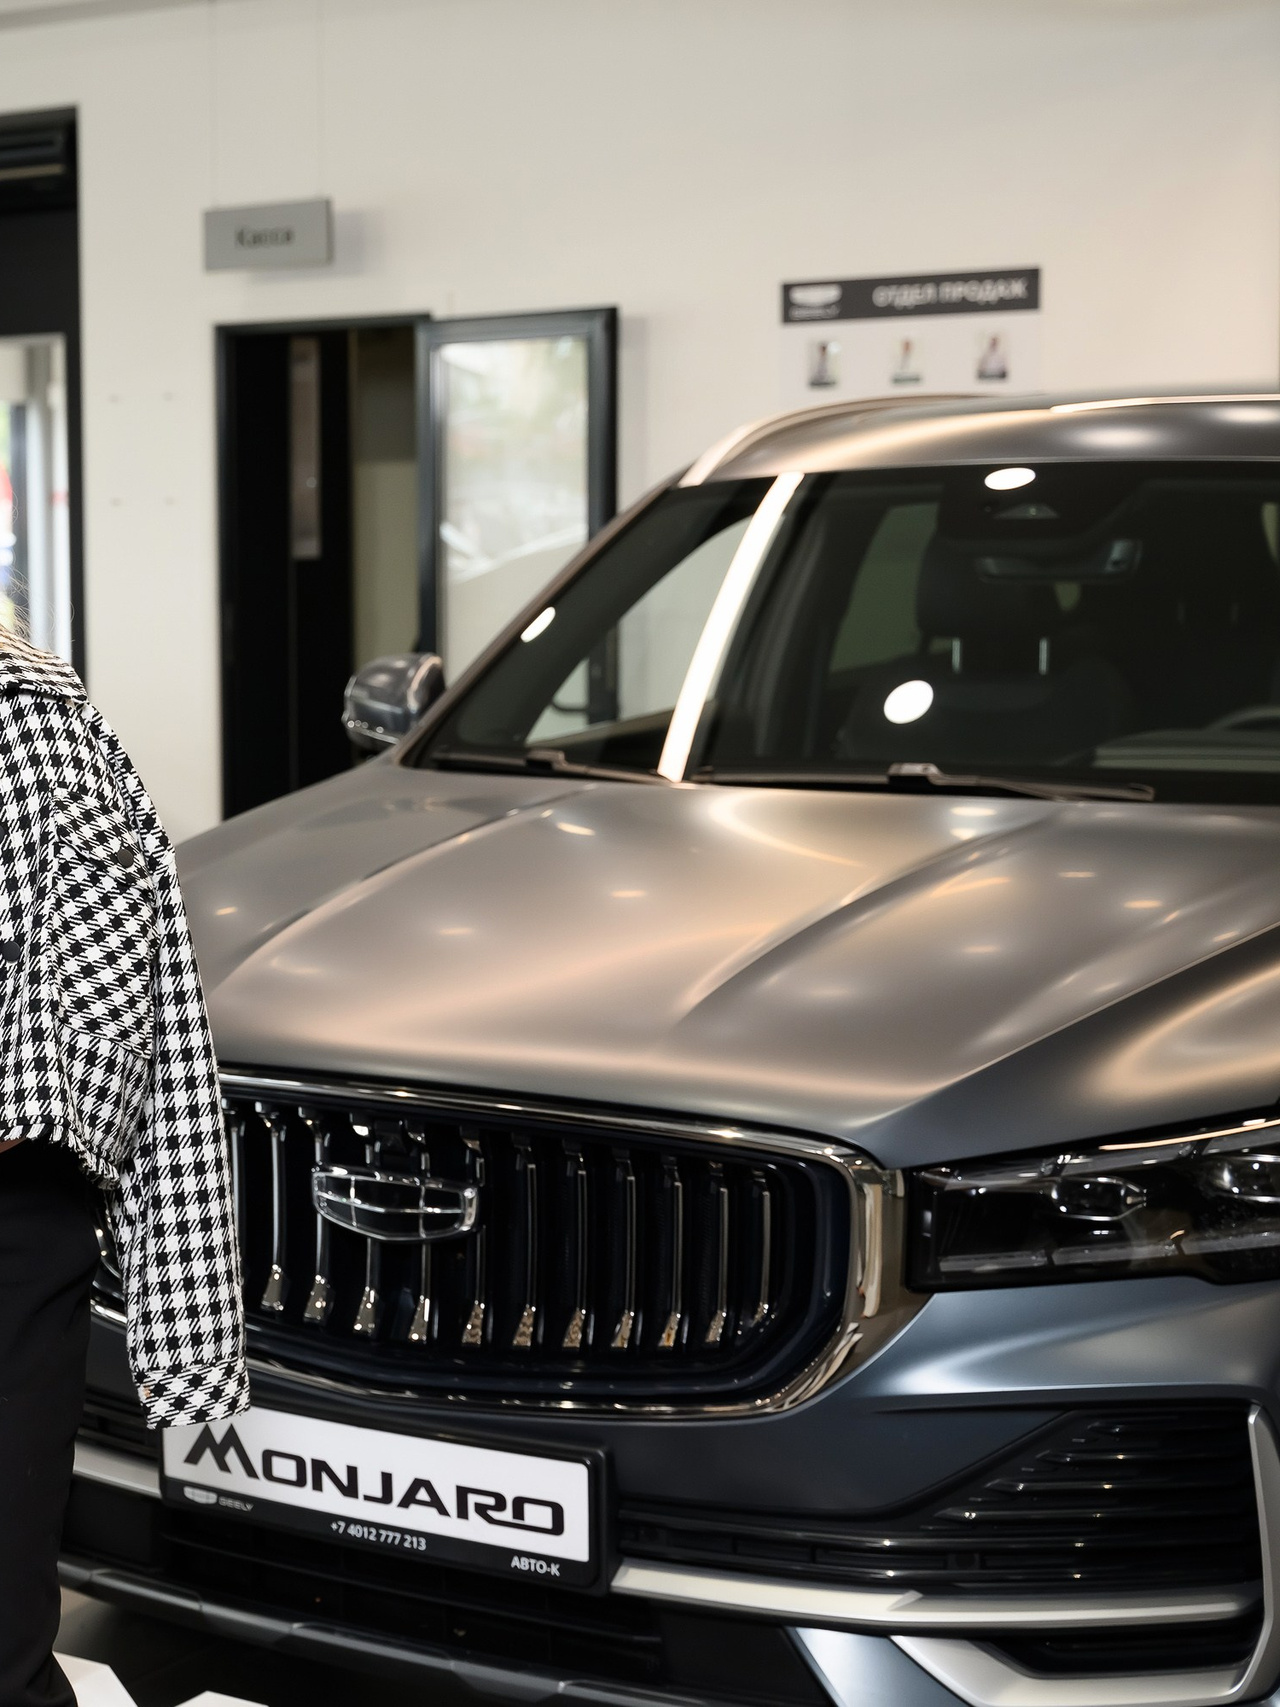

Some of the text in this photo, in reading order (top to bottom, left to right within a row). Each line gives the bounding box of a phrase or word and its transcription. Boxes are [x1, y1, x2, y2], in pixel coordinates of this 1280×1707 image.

[183, 1422, 565, 1537] MONJARO
[330, 1520, 427, 1551] +7 4012 777 213
